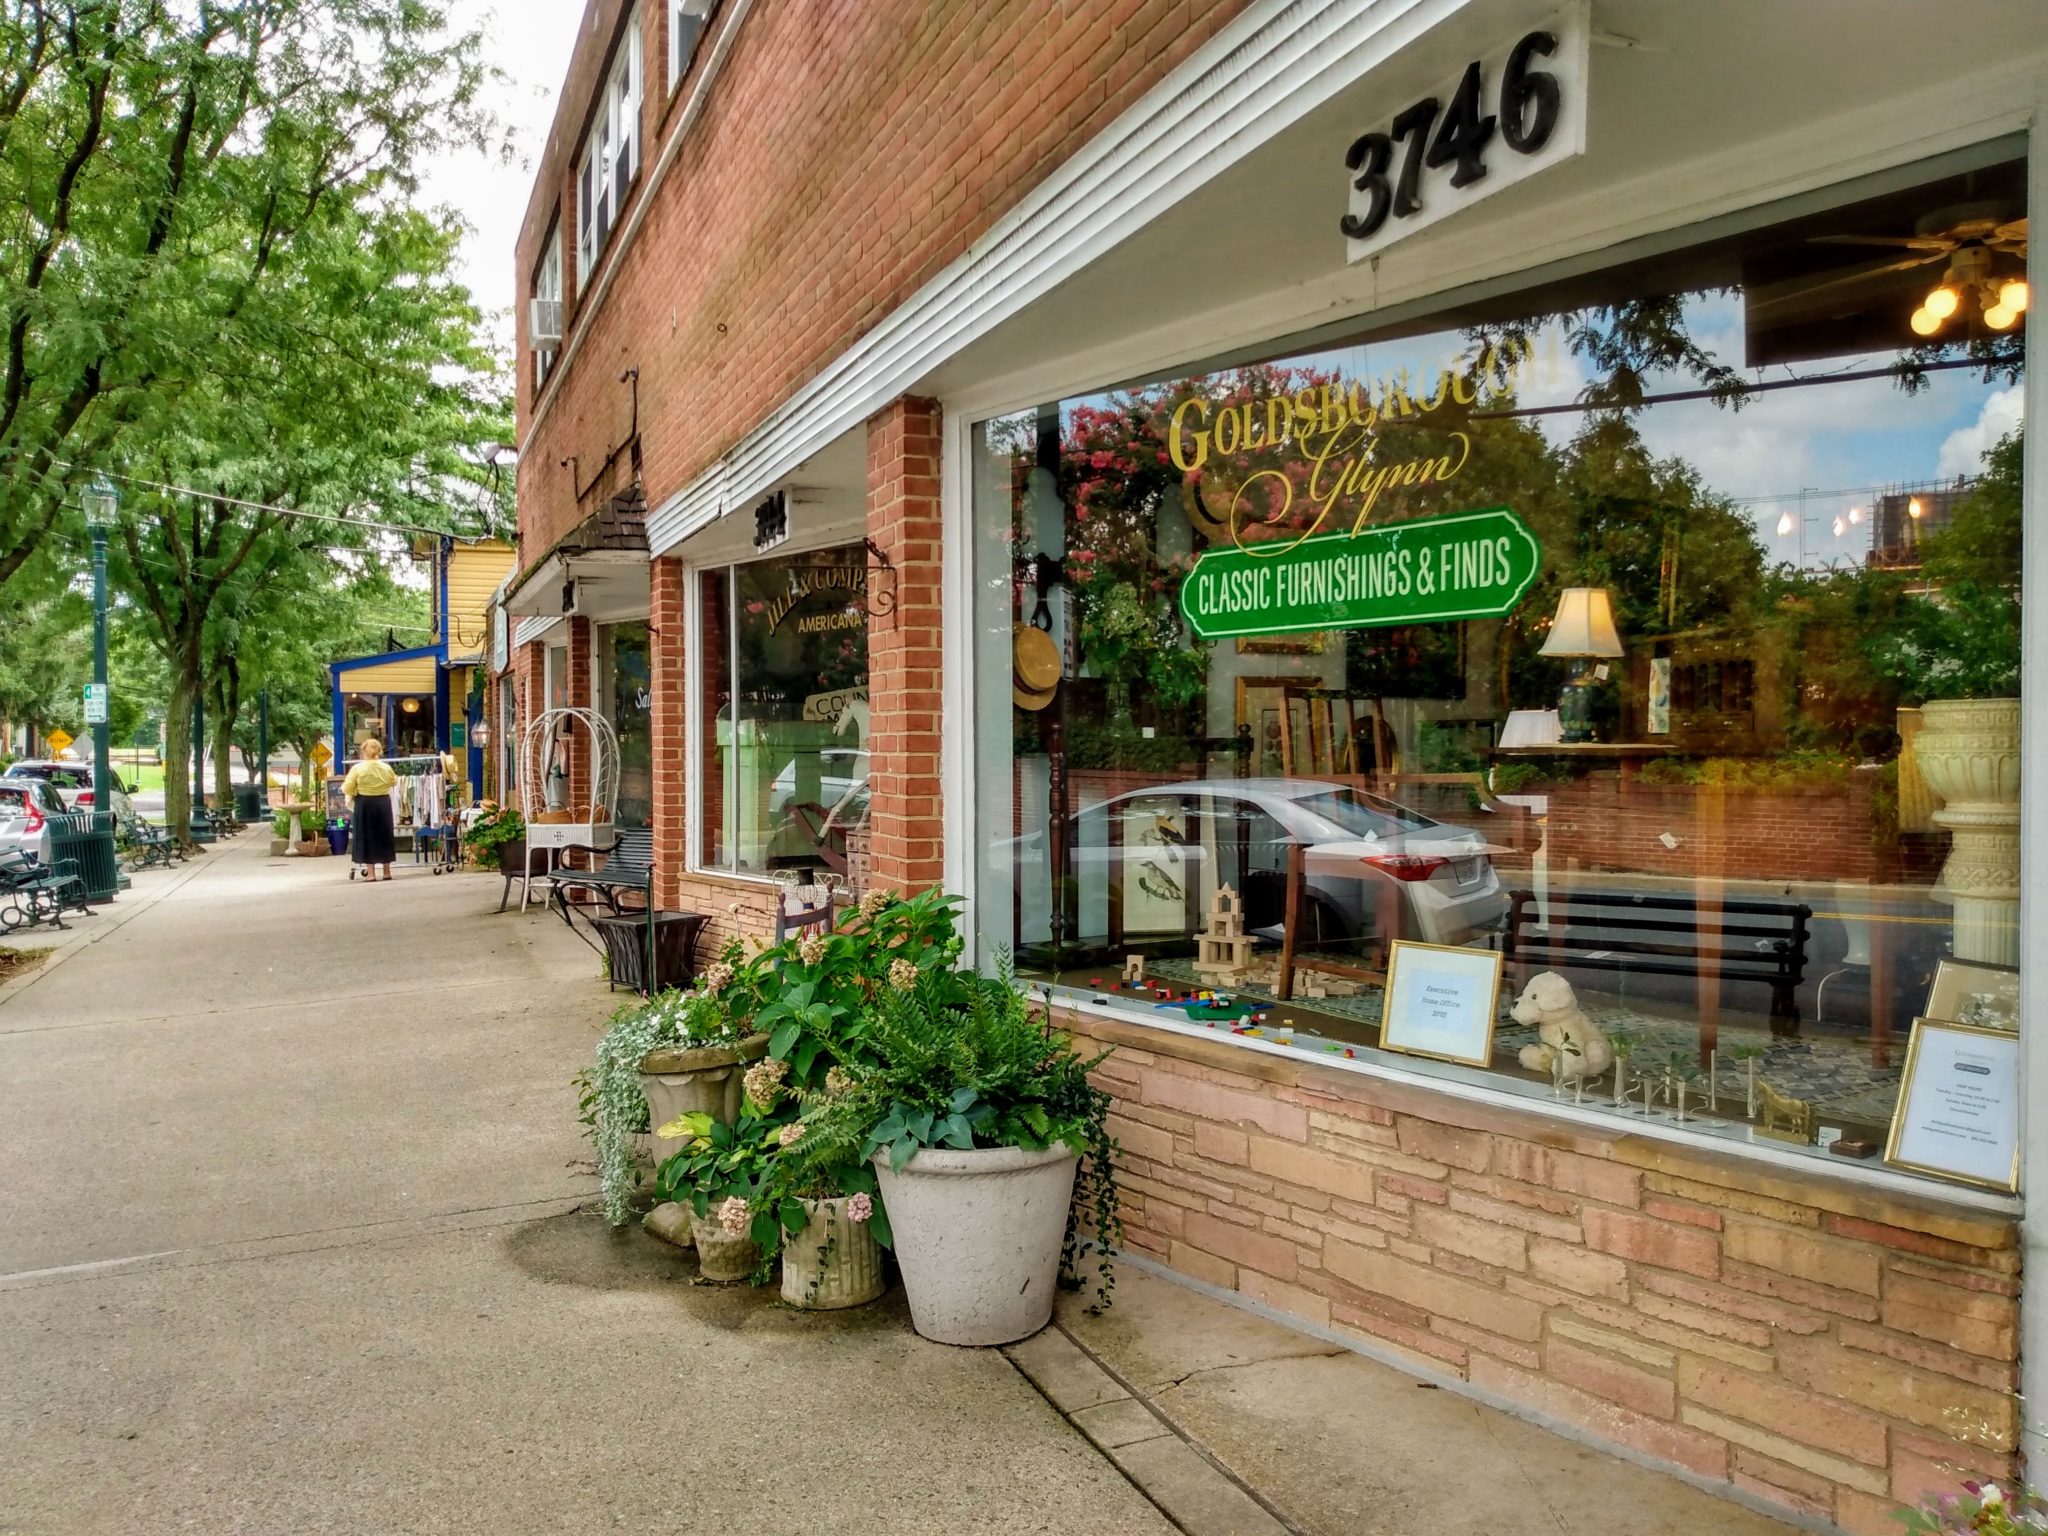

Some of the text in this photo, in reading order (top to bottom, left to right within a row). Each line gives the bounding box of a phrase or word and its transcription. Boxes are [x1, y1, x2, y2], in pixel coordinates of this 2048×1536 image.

[1340, 31, 1560, 240] 3746
[1198, 535, 1512, 616] CLASSIC FURNISHINGS & FINDS
[797, 613, 863, 634] AMERICANA
